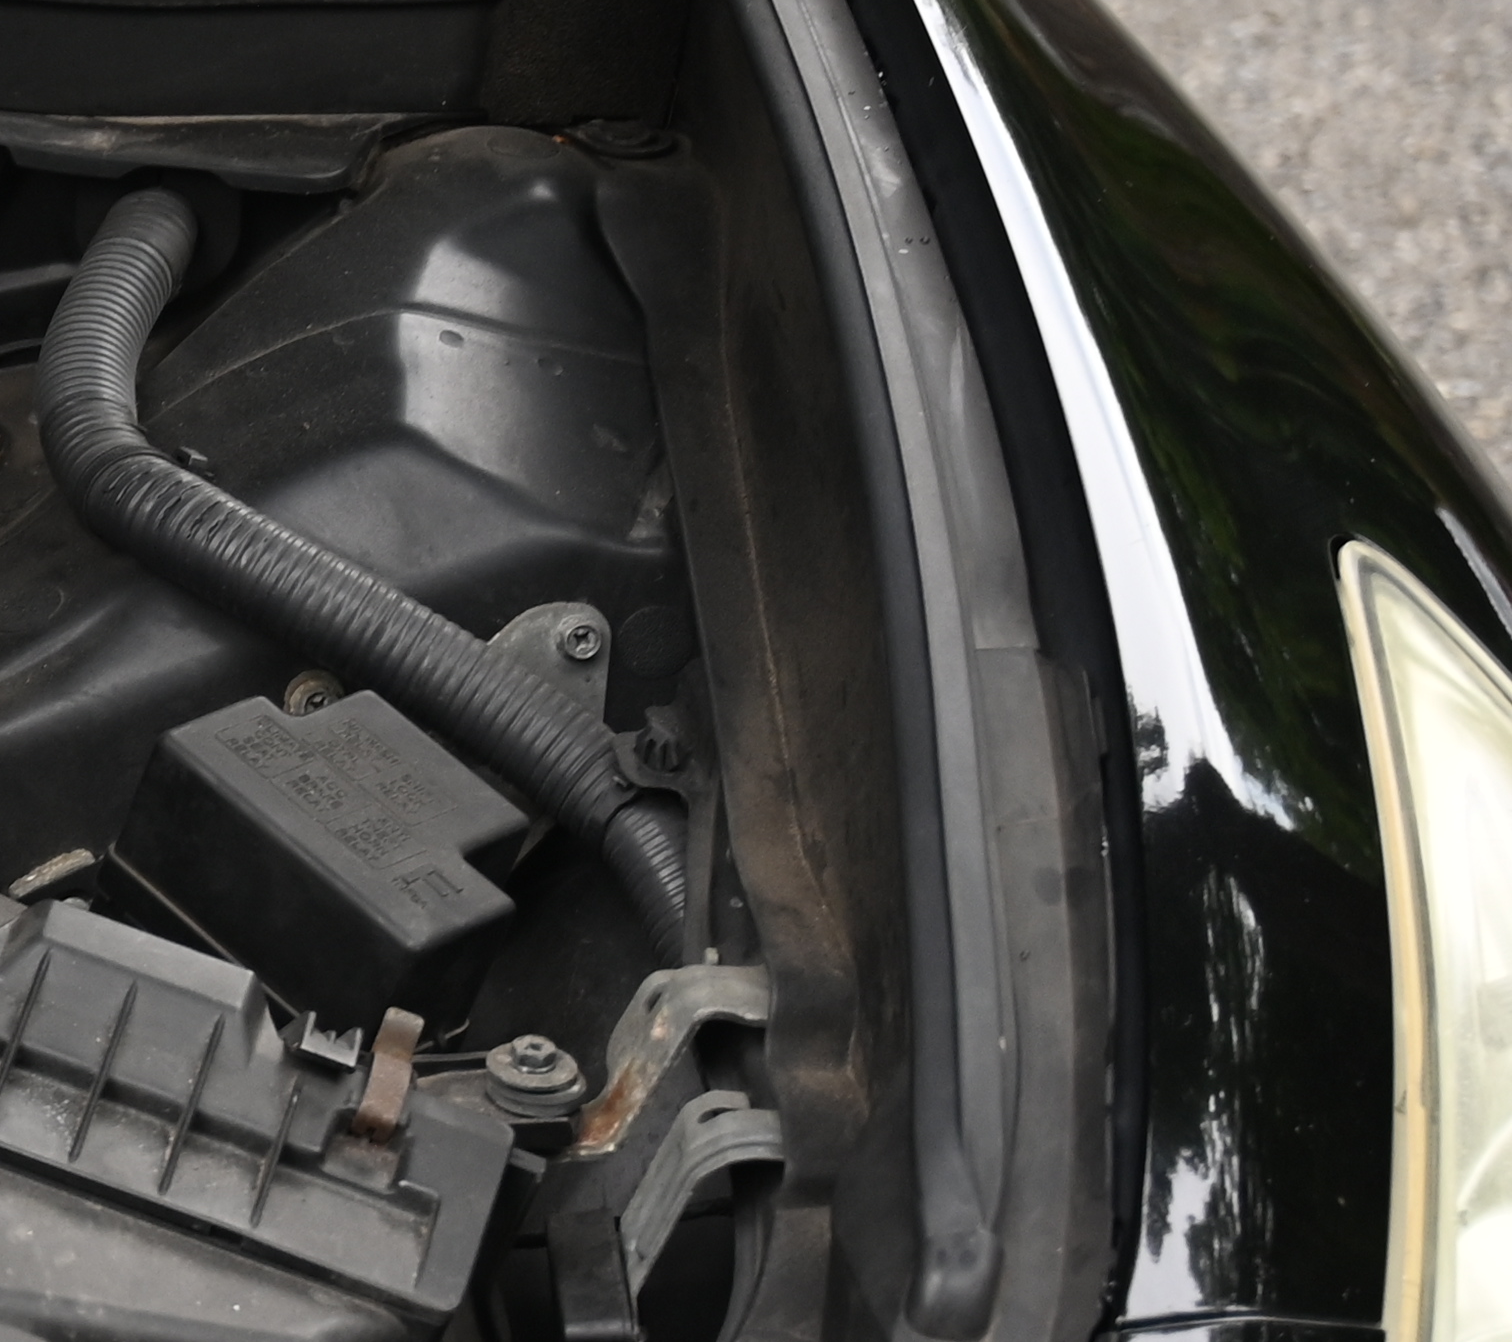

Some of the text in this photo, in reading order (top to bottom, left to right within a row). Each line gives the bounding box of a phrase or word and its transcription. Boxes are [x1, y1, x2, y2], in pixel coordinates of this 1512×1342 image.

[222, 737, 271, 770] RELAY
[240, 735, 278, 761] SEAT
[250, 729, 292, 758] CONT
[283, 779, 332, 813] RELAY
[332, 827, 382, 862] RELAY
[346, 823, 392, 855] HORN
